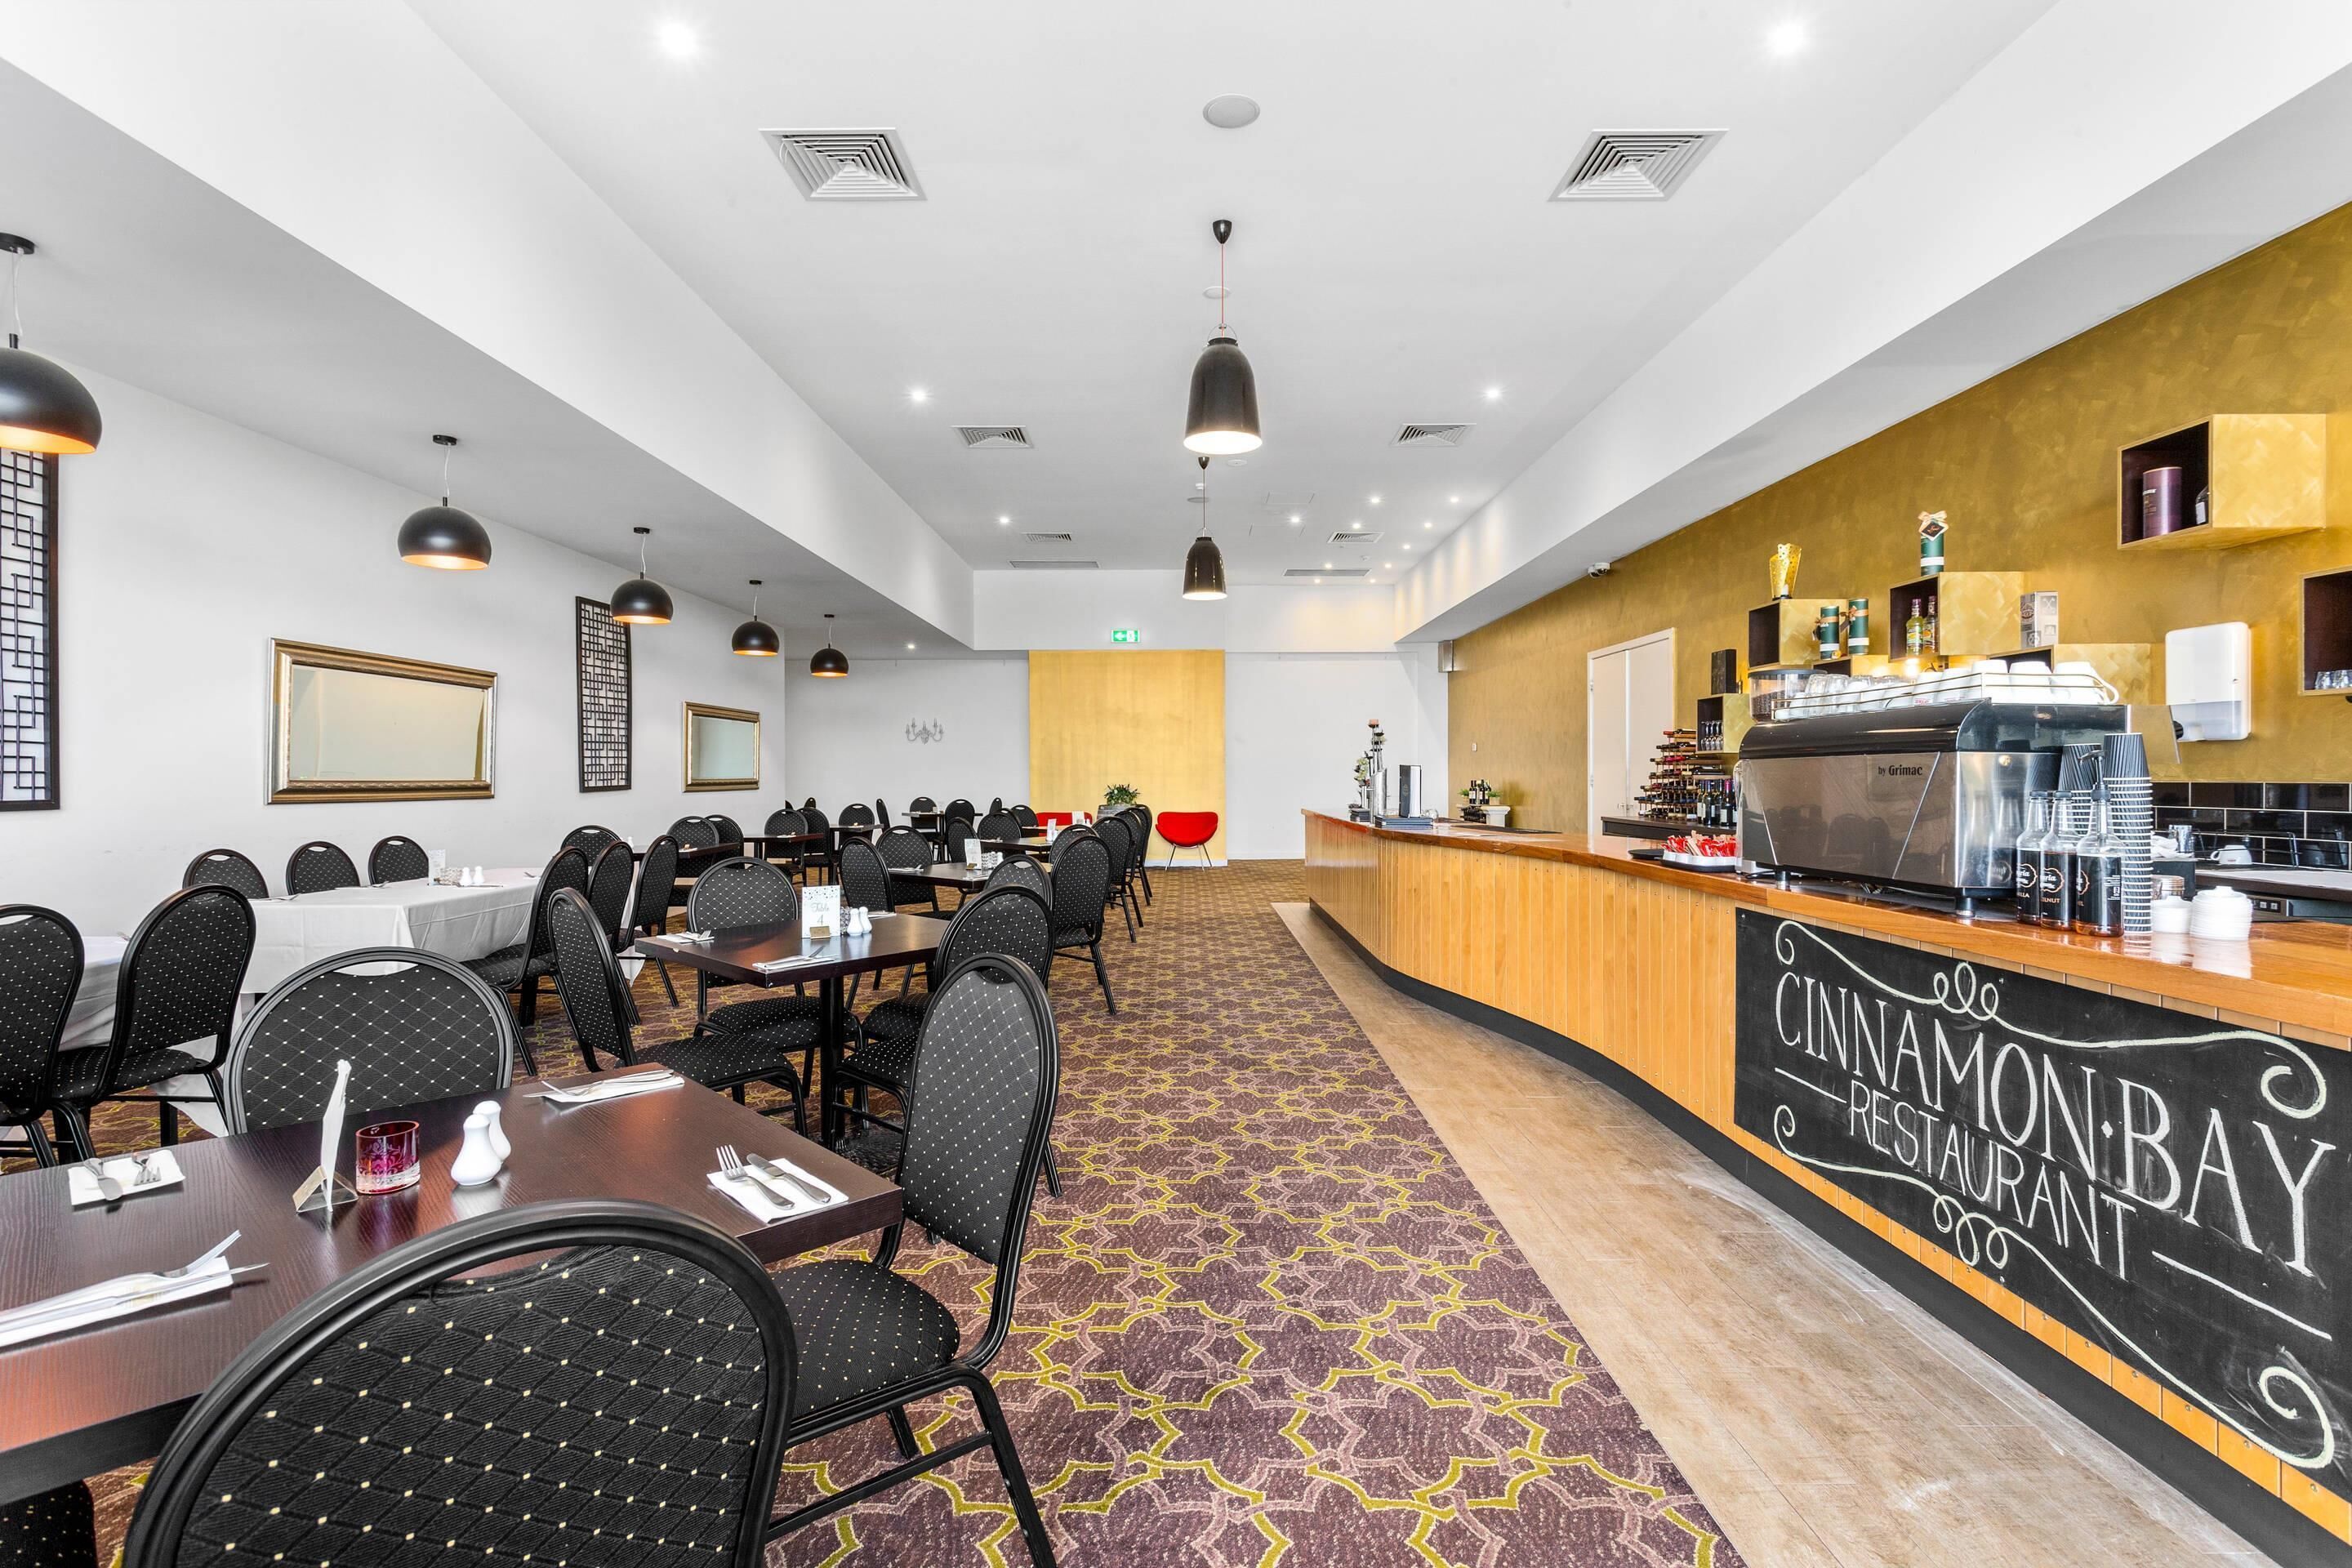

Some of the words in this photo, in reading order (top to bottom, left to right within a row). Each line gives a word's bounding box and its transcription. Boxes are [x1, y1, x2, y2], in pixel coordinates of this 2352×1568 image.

[1878, 766, 1886, 776] by
[1888, 764, 1922, 776] Grimac
[817, 914, 824, 925] 4
[1850, 1079, 2137, 1281] RESTAURANT
